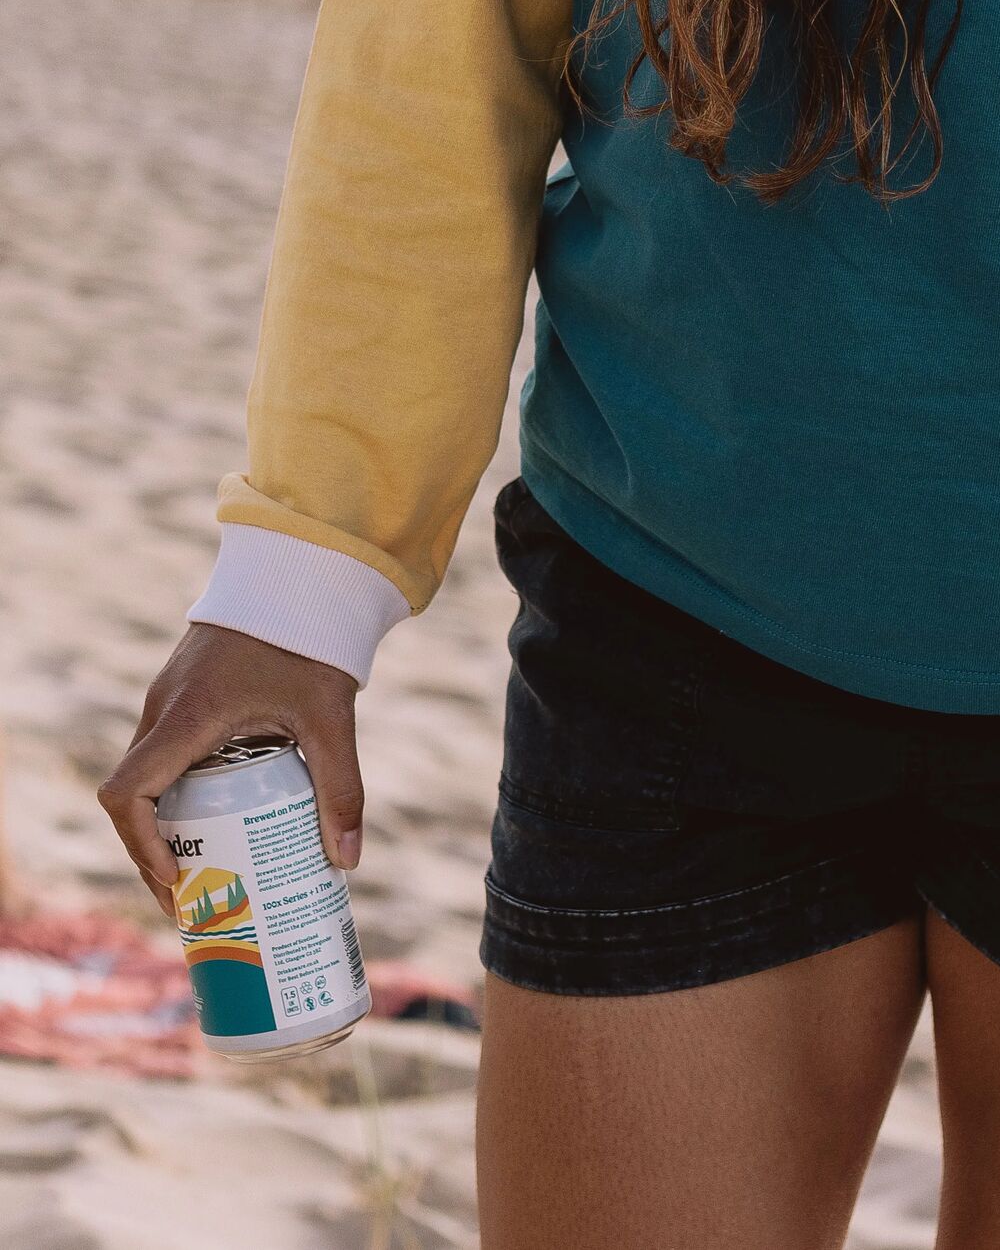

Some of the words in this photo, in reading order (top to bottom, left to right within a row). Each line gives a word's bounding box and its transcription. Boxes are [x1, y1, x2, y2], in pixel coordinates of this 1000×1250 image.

[243, 810, 276, 825] Brewed
[278, 808, 288, 816] on
[250, 838, 286, 851] environment
[256, 868, 277, 877] Brewed
[262, 900, 282, 910] 100x
[283, 892, 308, 905] Series
[319, 880, 333, 892] Tree
[279, 918, 295, 927] plants
[268, 928, 284, 936] roots
[272, 942, 292, 952] Product
[273, 948, 301, 959] Distributed
[299, 970, 314, 978] Before
[284, 990, 296, 1000] 1.5
